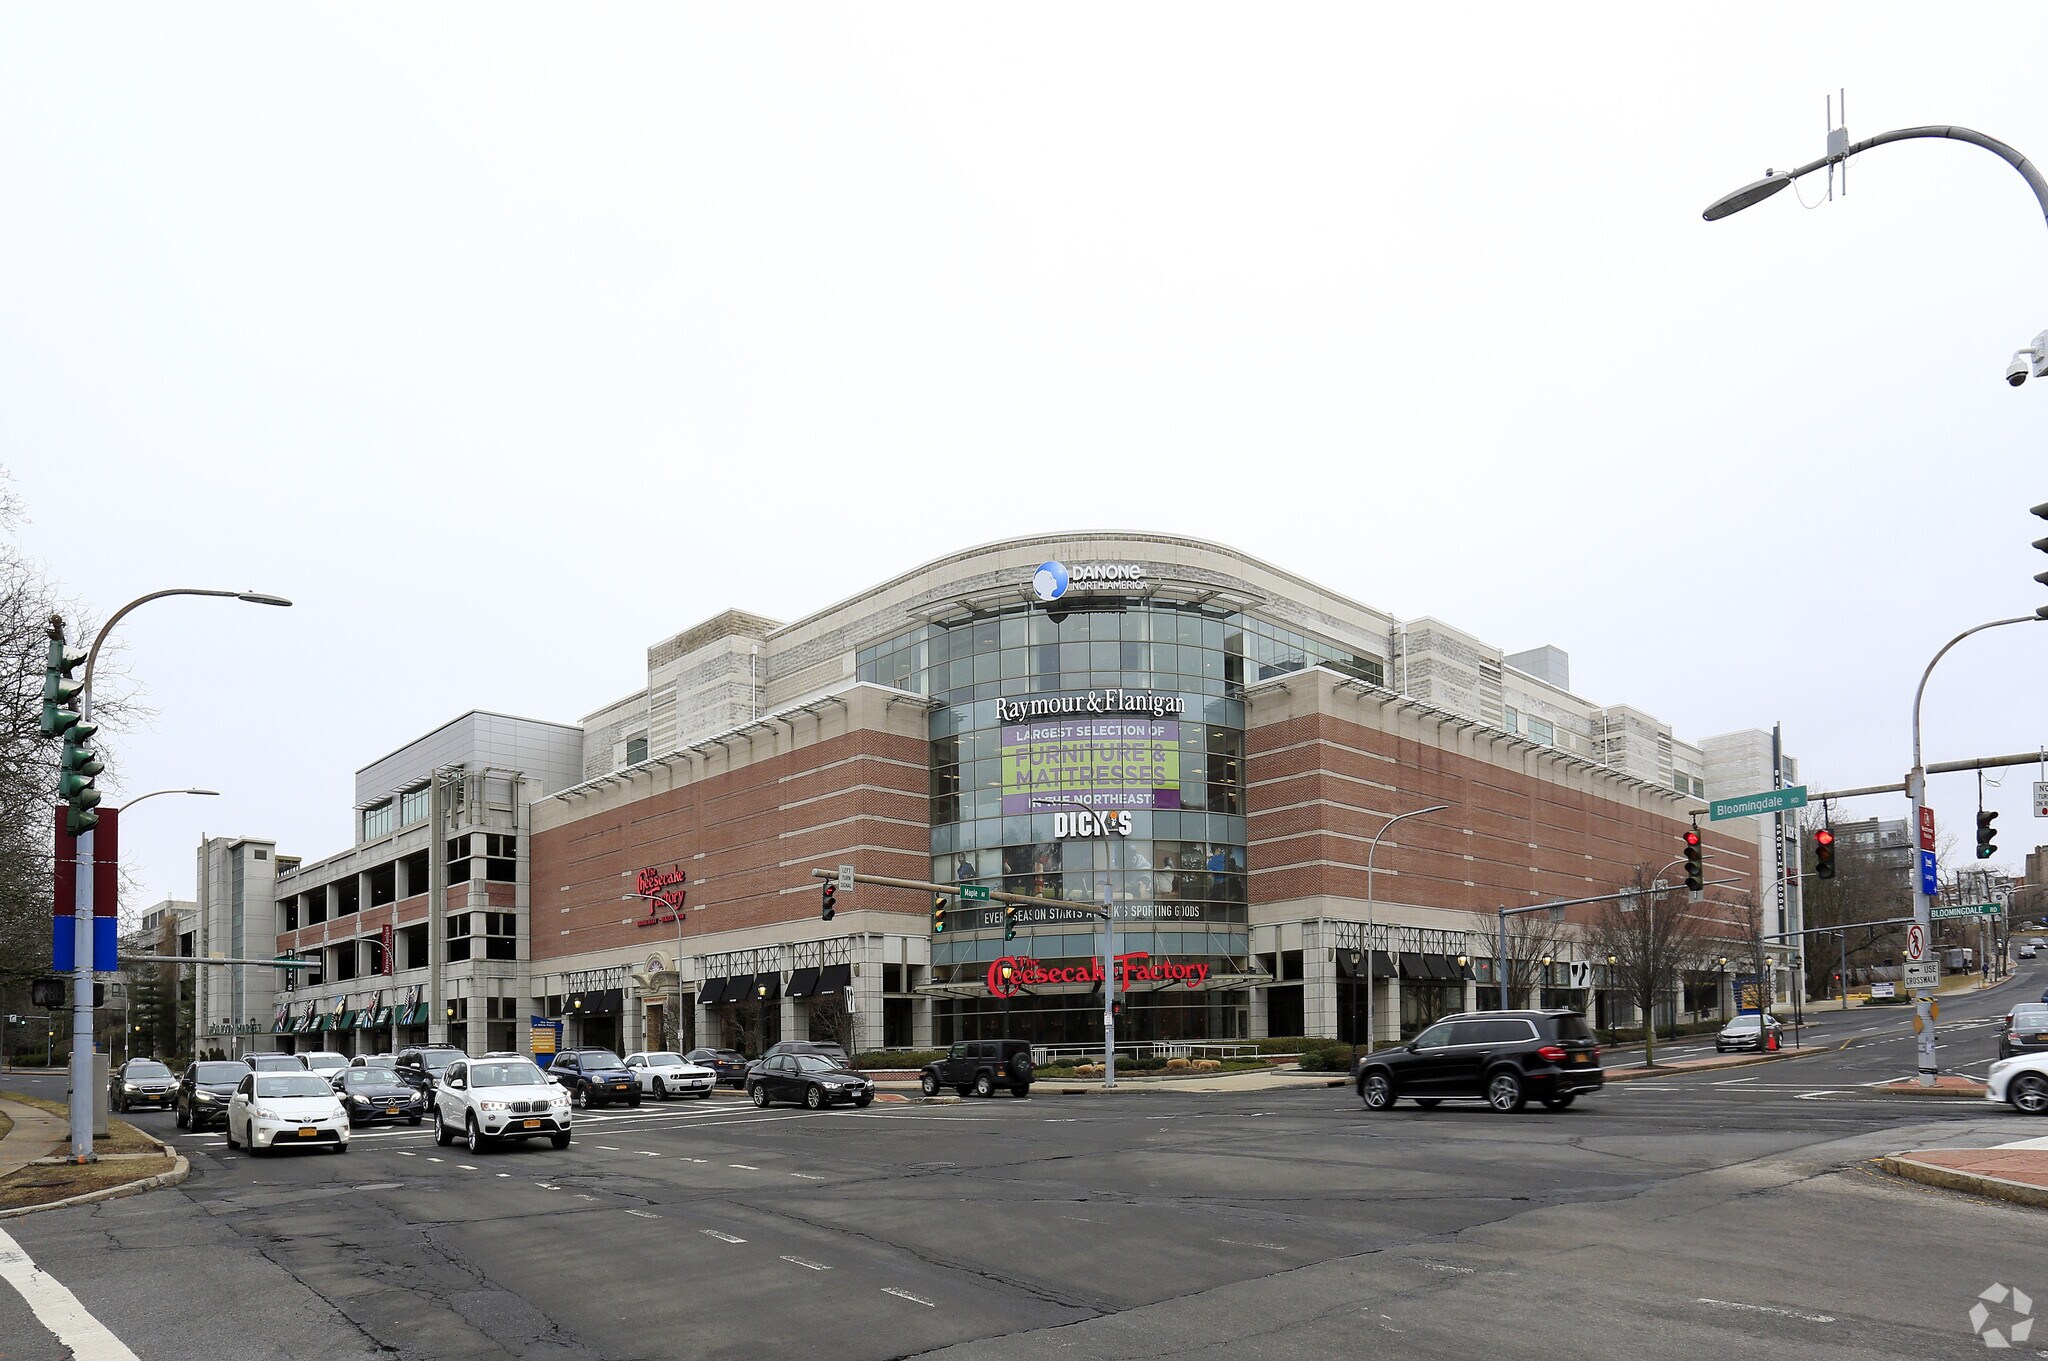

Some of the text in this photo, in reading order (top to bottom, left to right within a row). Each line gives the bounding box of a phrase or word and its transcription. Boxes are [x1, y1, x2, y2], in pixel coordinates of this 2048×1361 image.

[1072, 580, 1148, 591] NORTH AMERICA
[994, 688, 1186, 722] Raymour & Flanigan
[1016, 725, 1165, 741] LARGEST SELECTION OF
[1015, 742, 1166, 767] FURNITURE &
[1016, 765, 1166, 790] MATTRESSES
[1074, 793, 1155, 806] NORTHEAST!
[1717, 796, 1783, 816] Bloomingdale
[1054, 810, 1132, 838] DICK'S
[964, 888, 978, 898] Maple
[984, 911, 1004, 924] EVER
[1131, 905, 1172, 917] SPORTING
[1931, 905, 1984, 918] BLOOMINGDALE
[1017, 955, 1040, 968] The
[1113, 951, 1210, 993] Factory
[1923, 965, 1937, 974] USE
[1906, 976, 1937, 985] CROSSWALK
